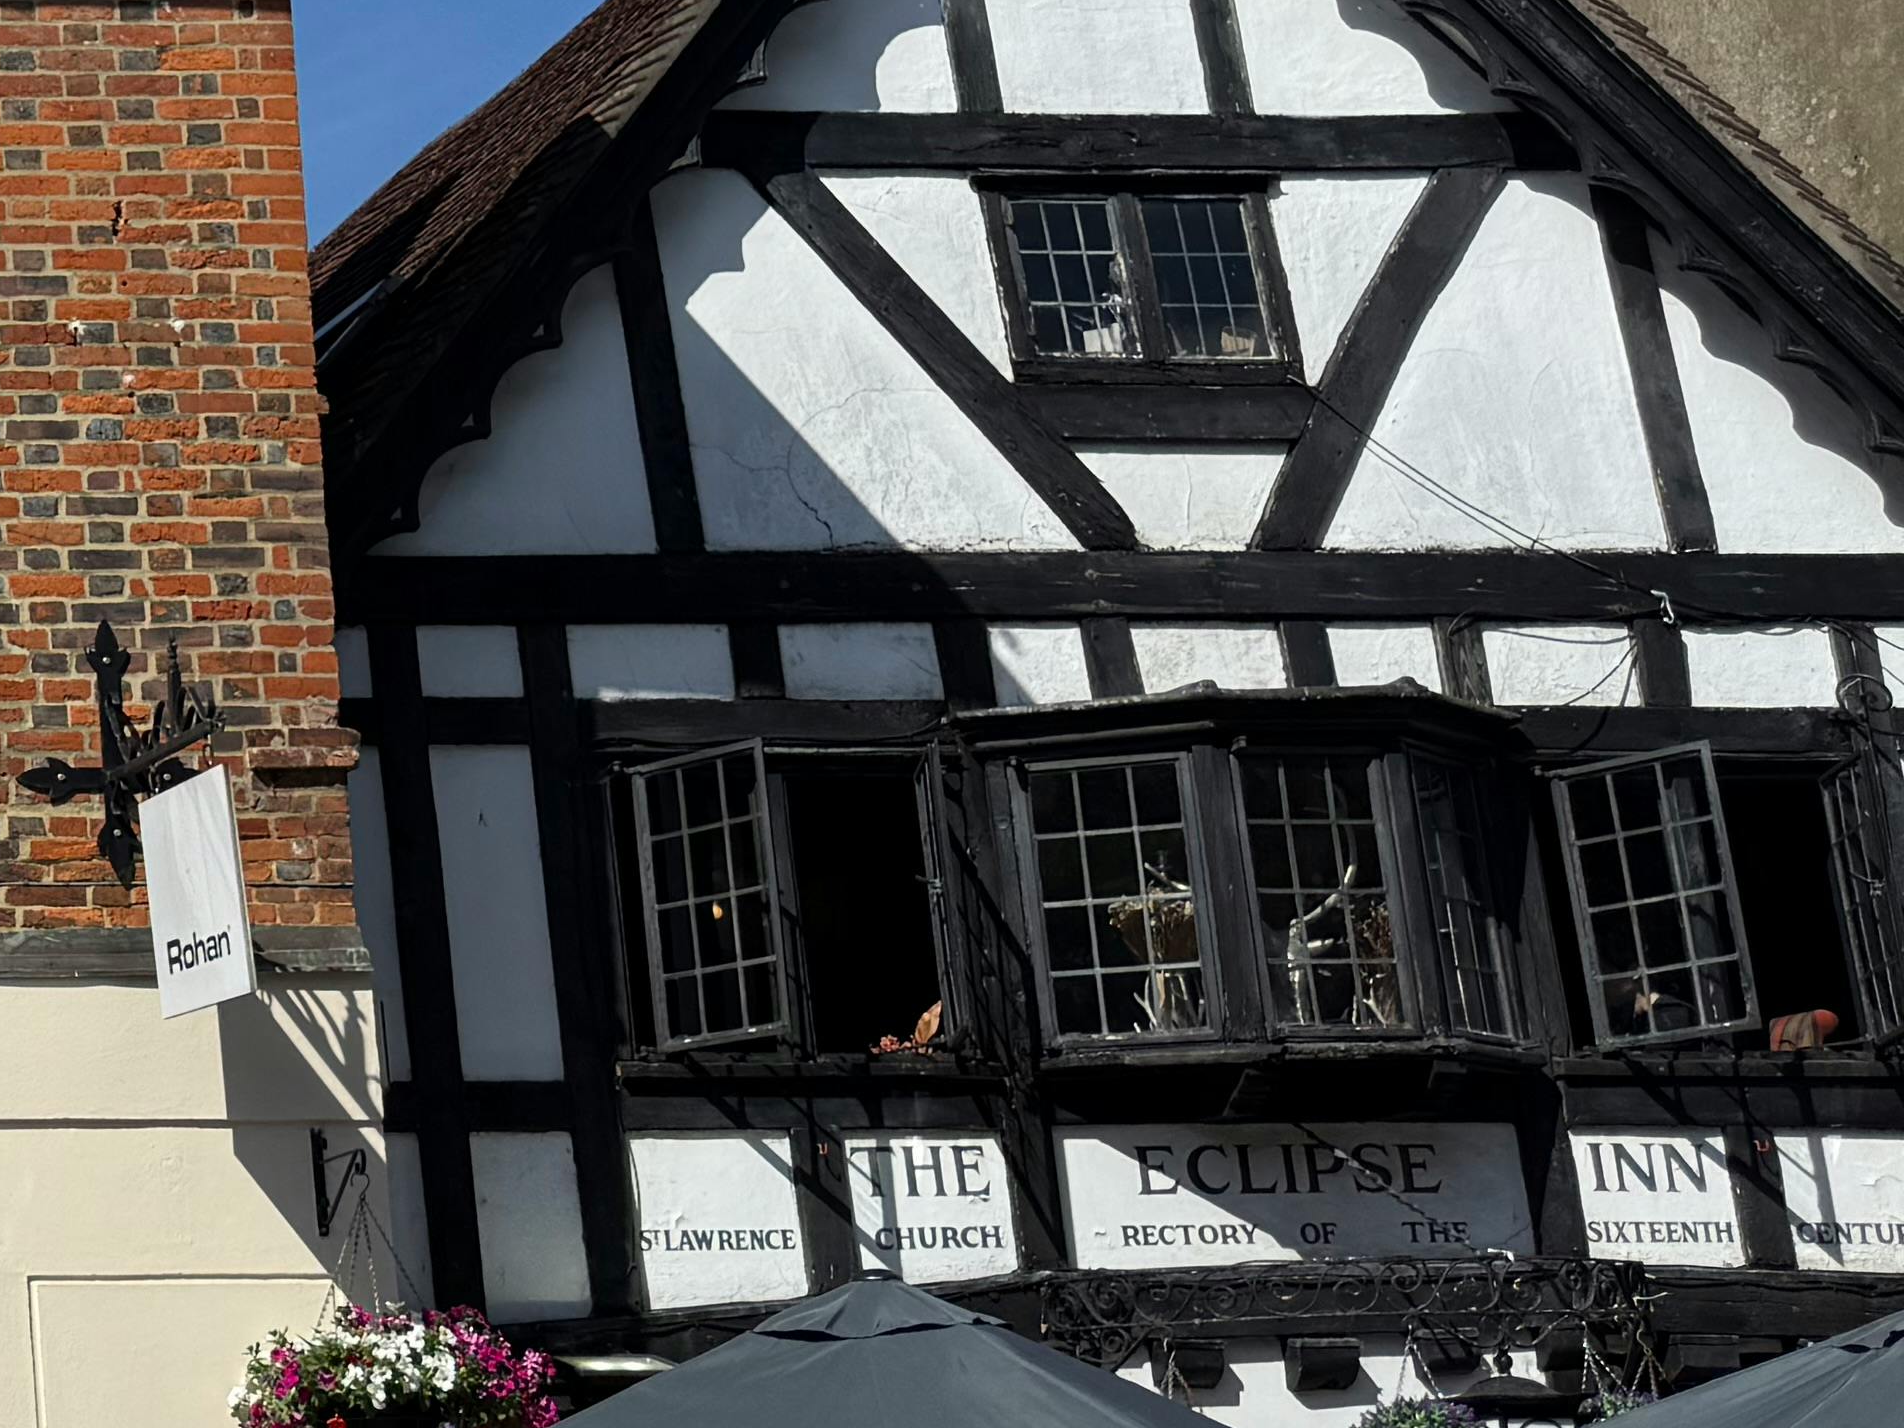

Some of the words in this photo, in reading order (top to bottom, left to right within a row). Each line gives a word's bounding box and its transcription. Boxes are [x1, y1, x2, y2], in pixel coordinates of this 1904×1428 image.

[167, 930, 231, 974] Rohan
[850, 1145, 991, 1197] THE
[1133, 1142, 1443, 1196] ECLIPSE
[1586, 1142, 1708, 1193] INN
[665, 1228, 797, 1251] LAWRENCE
[875, 1225, 1005, 1251] CHURCH
[1122, 1224, 1259, 1247] RECTORY
[1300, 1222, 1338, 1245] OF
[1400, 1221, 1473, 1245] THE
[1588, 1221, 1735, 1244] SIXTEENTH
